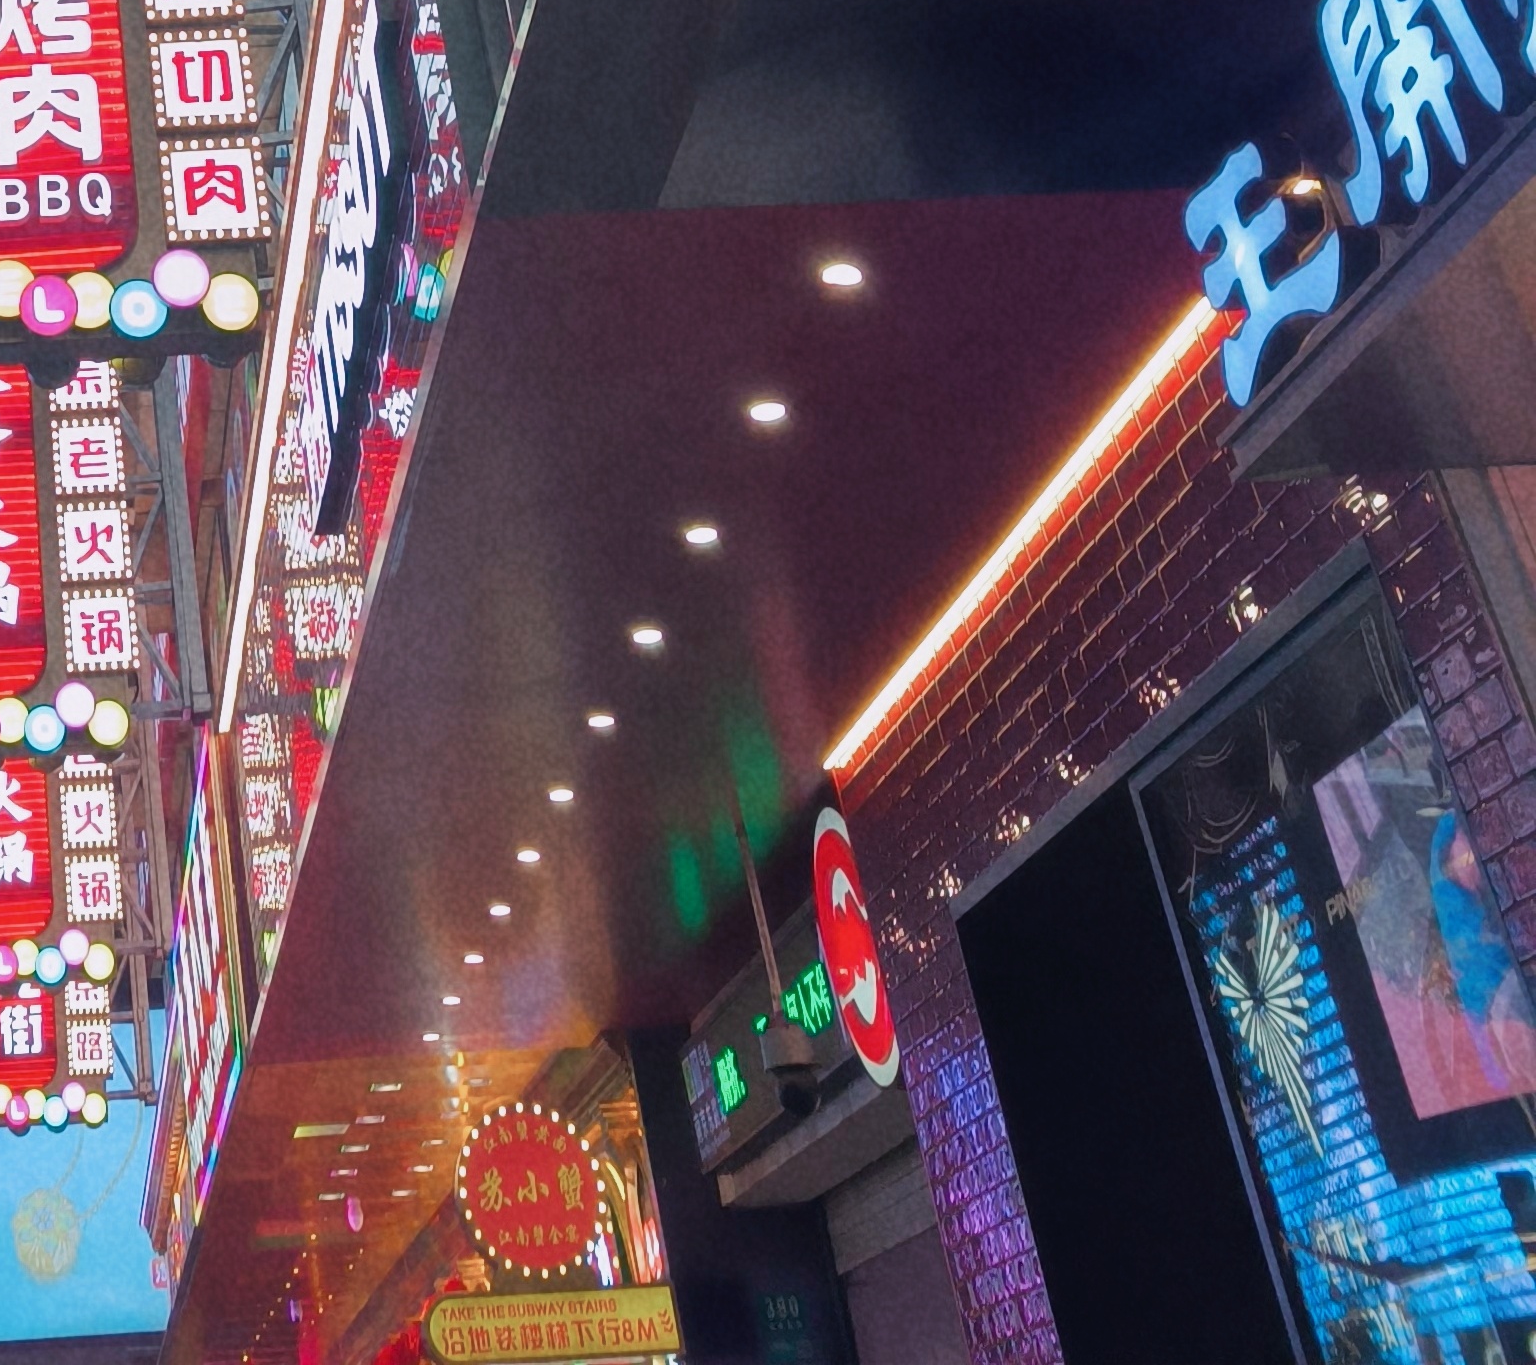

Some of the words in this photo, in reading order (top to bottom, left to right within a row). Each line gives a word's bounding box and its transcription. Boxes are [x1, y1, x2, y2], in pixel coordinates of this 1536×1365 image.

[70, 755, 111, 908] 火锅
[477, 1162, 585, 1212] 苏小蟹
[440, 1306, 475, 1322] TAKE
[480, 1304, 505, 1320] THE
[508, 1300, 565, 1319] SUBWAY
[568, 1297, 618, 1314] STAIRS
